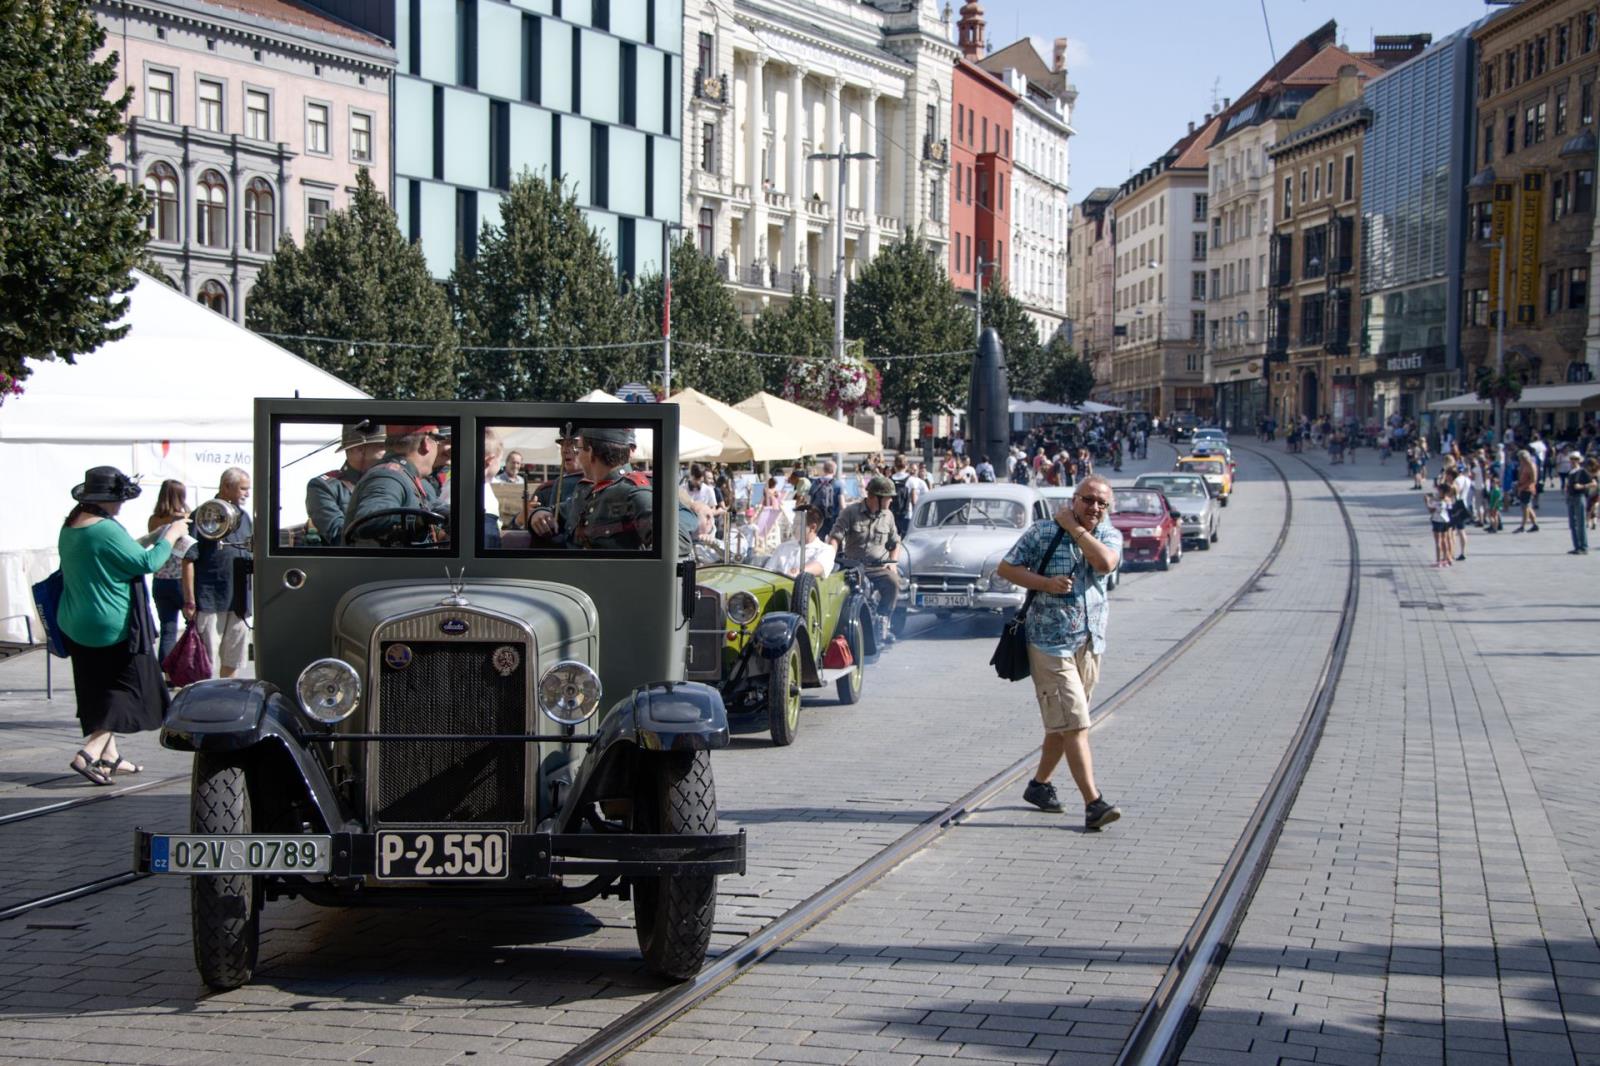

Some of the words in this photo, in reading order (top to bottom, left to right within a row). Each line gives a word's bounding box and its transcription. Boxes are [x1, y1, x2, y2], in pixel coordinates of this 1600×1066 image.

[195, 450, 221, 464] vína
[224, 454, 231, 464] z
[154, 858, 168, 868] CZ
[175, 841, 226, 869] 02V
[248, 841, 317, 868] 0789
[382, 834, 503, 875] P-2.550
